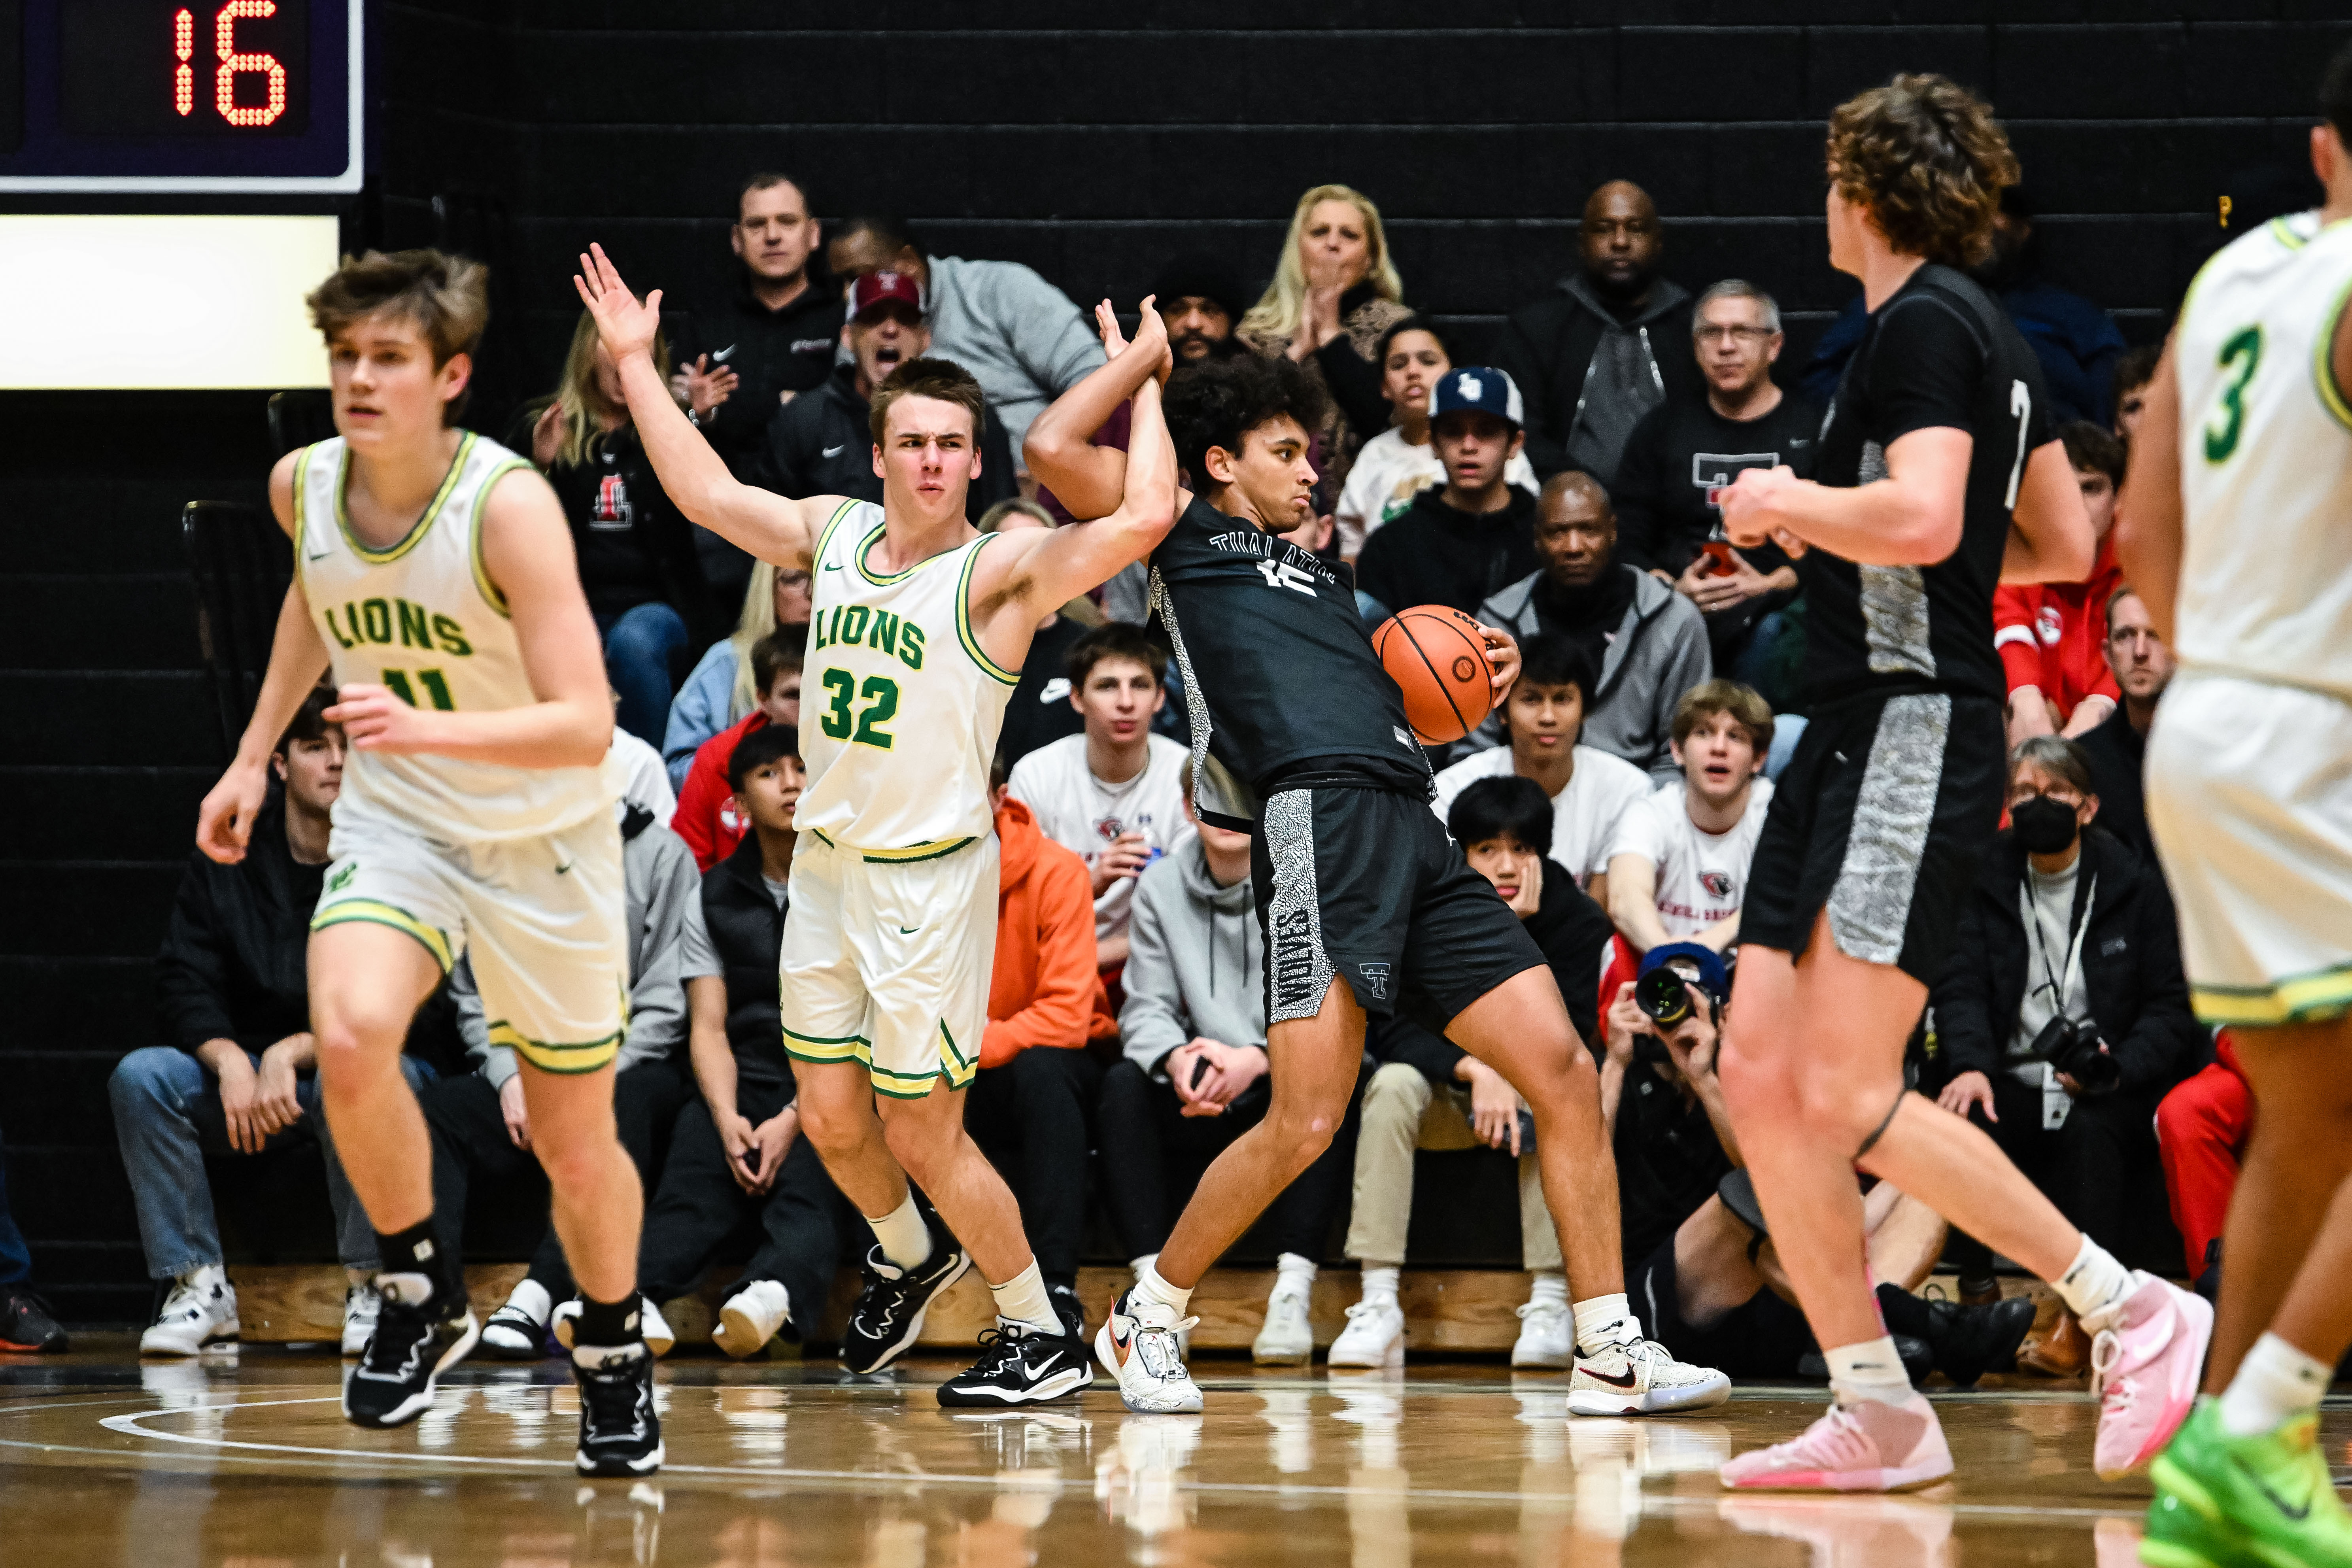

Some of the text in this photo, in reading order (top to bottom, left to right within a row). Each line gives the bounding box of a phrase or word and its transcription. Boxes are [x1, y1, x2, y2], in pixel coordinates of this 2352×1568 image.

[176, 0, 285, 126] 16
[2202, 323, 2263, 463] 3
[325, 597, 473, 657] LIONS
[815, 605, 926, 671] LIONS
[820, 667, 899, 751] 32
[1276, 909, 1314, 1008] WOLVES
